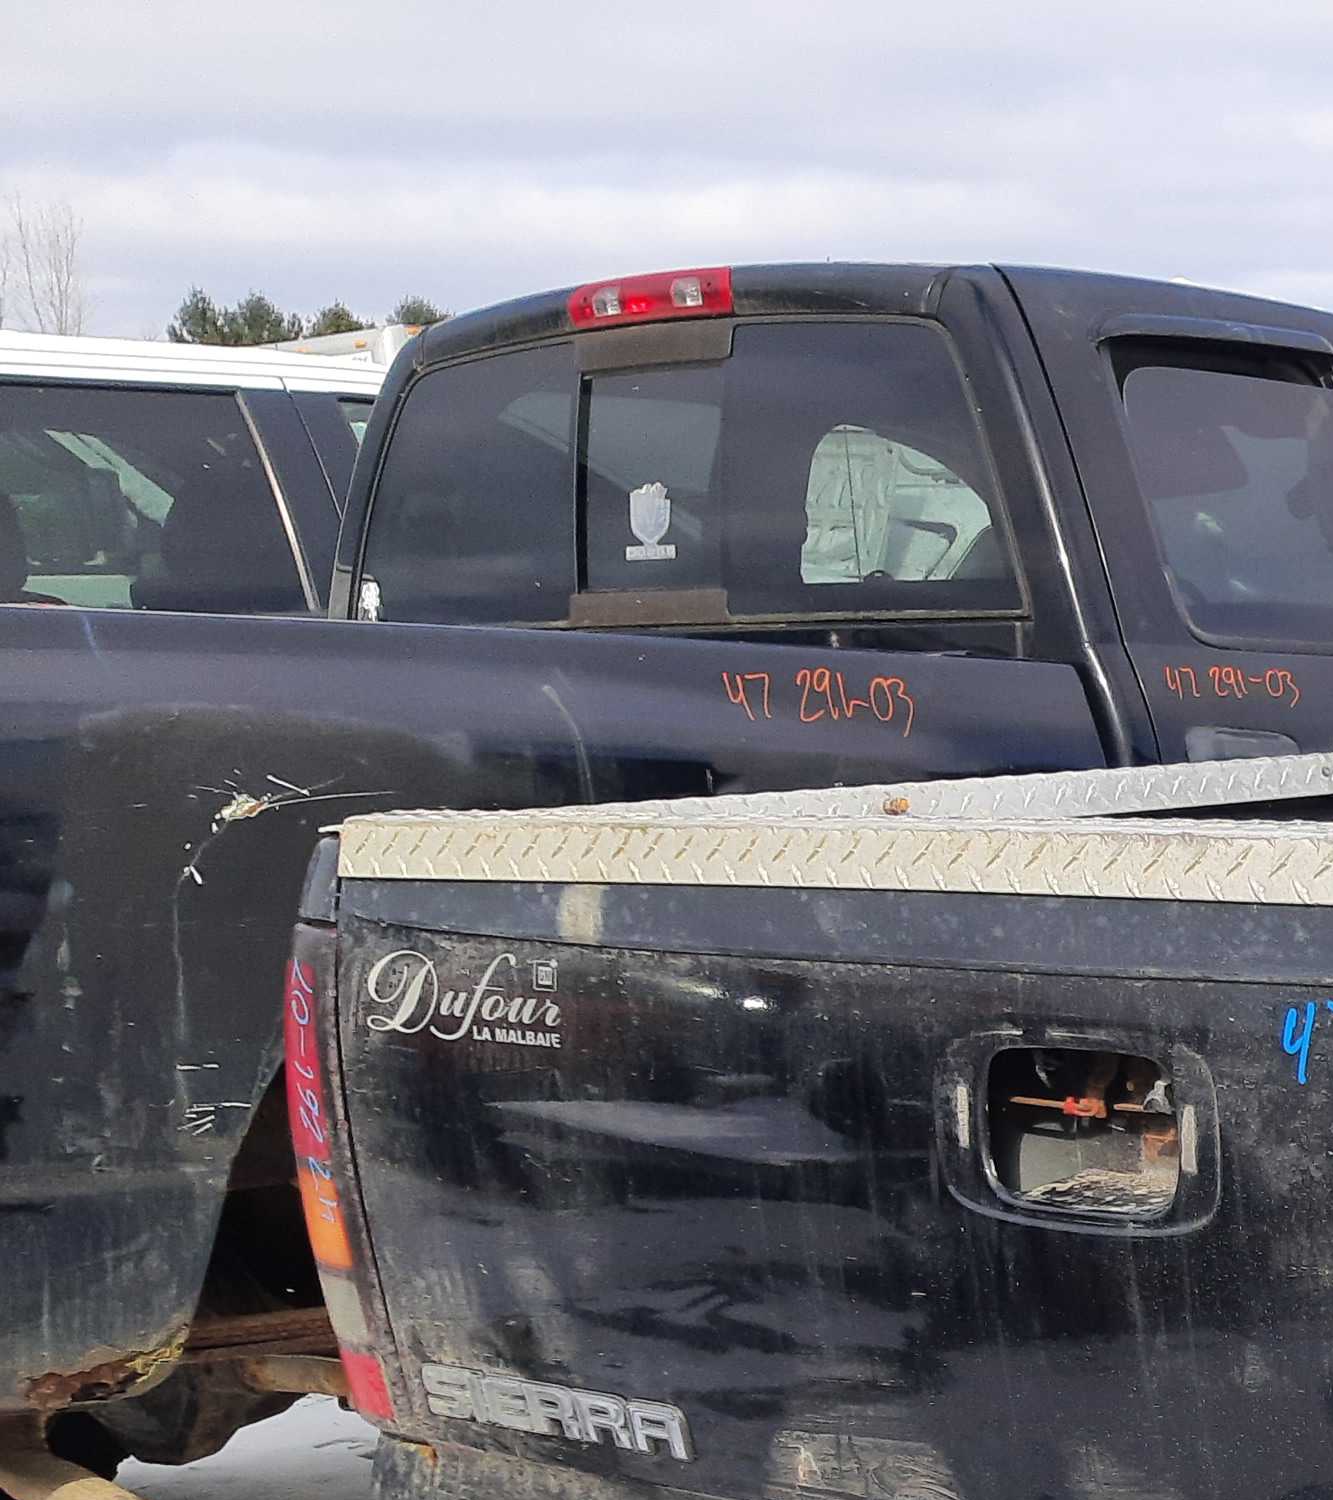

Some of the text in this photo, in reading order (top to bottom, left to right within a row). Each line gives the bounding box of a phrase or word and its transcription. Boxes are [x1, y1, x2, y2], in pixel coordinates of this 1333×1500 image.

[722, 667, 915, 738] 47 291-03
[1164, 665, 1299, 709] 47 291-03
[366, 949, 561, 1041] Dufour
[471, 1024, 562, 1049] LA MALBAIE
[421, 1360, 692, 1464] SIERRA
